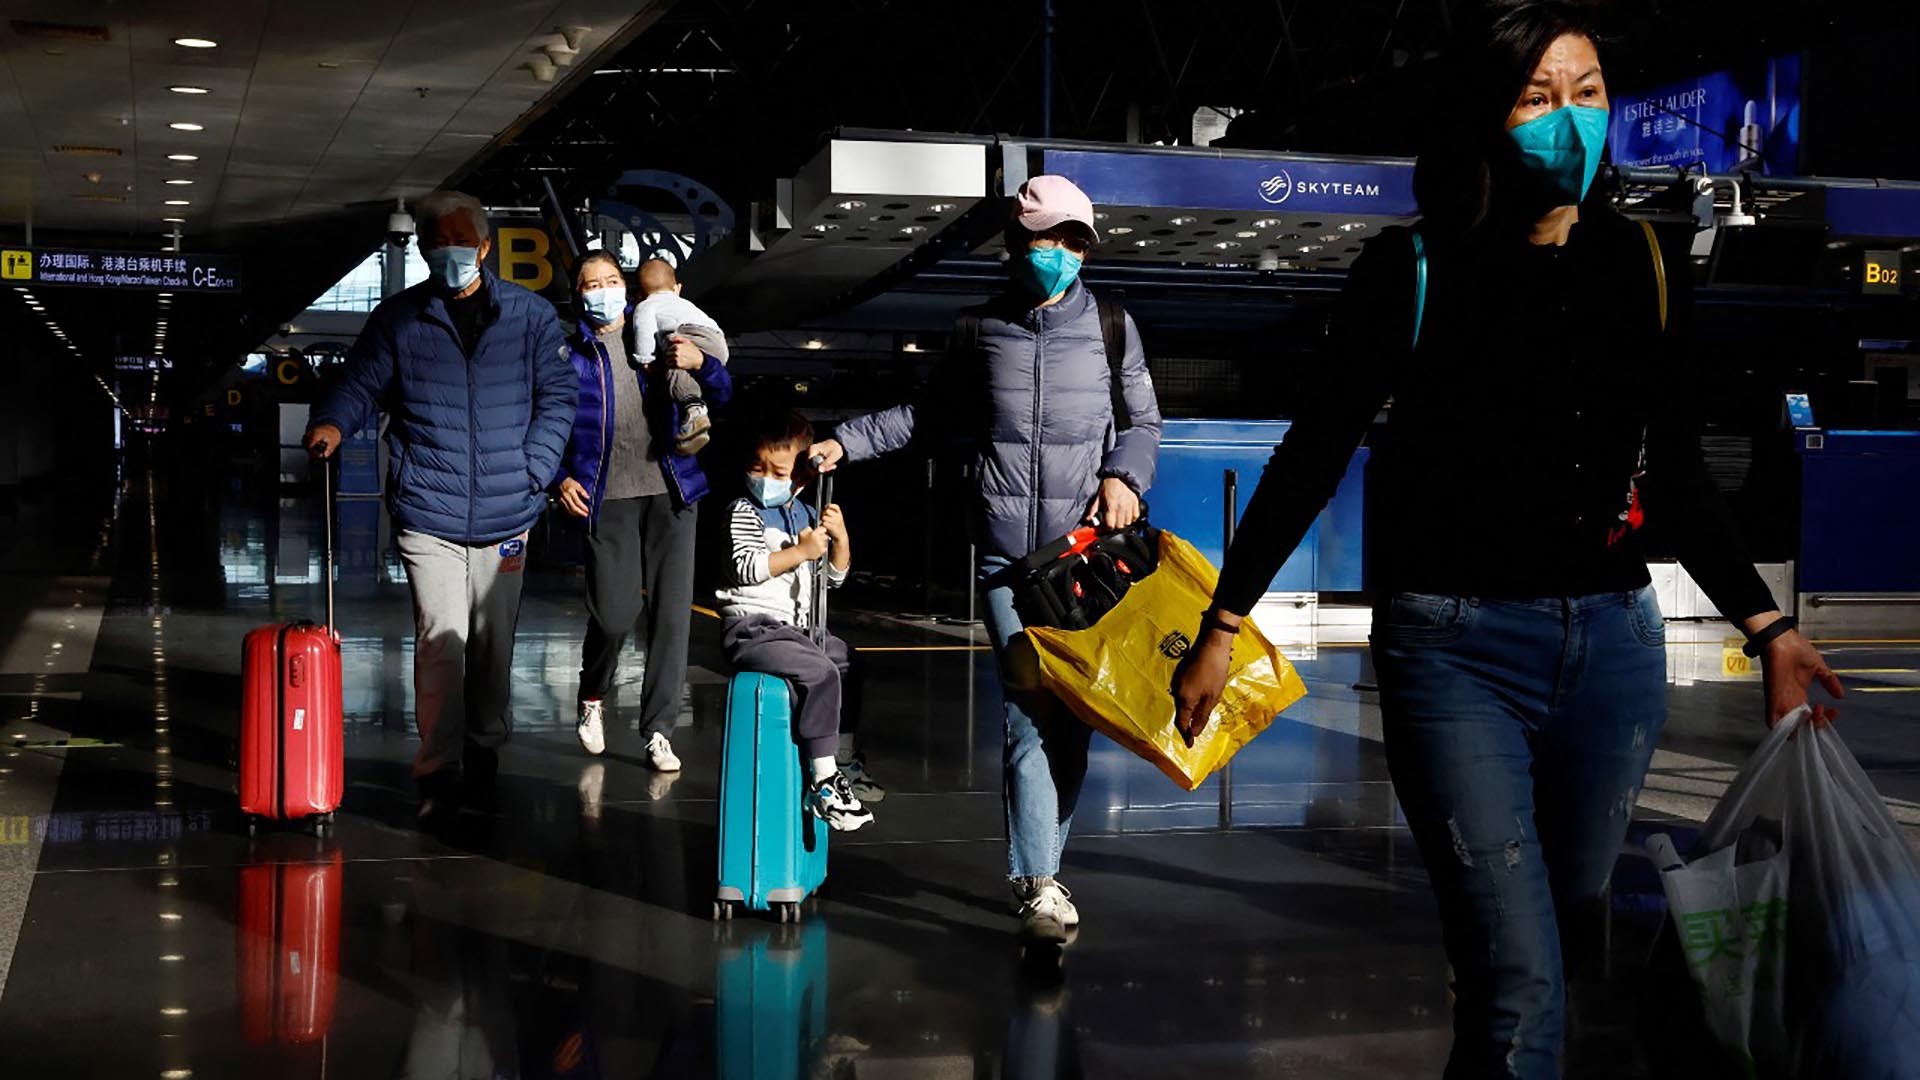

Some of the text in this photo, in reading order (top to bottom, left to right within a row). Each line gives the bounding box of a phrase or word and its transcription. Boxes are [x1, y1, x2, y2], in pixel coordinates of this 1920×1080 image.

[1659, 88, 1707, 114] LAUDER
[1297, 181, 1379, 196] SKYTEAM
[498, 228, 553, 292] B
[40, 271, 76, 282] International
[77, 274, 88, 282] and
[89, 274, 104, 286] Hong
[163, 276, 189, 286] Check-in
[1866, 263, 1897, 284] B02
[277, 360, 300, 385] C
[227, 389, 241, 406] D
[204, 403, 216, 416] E
